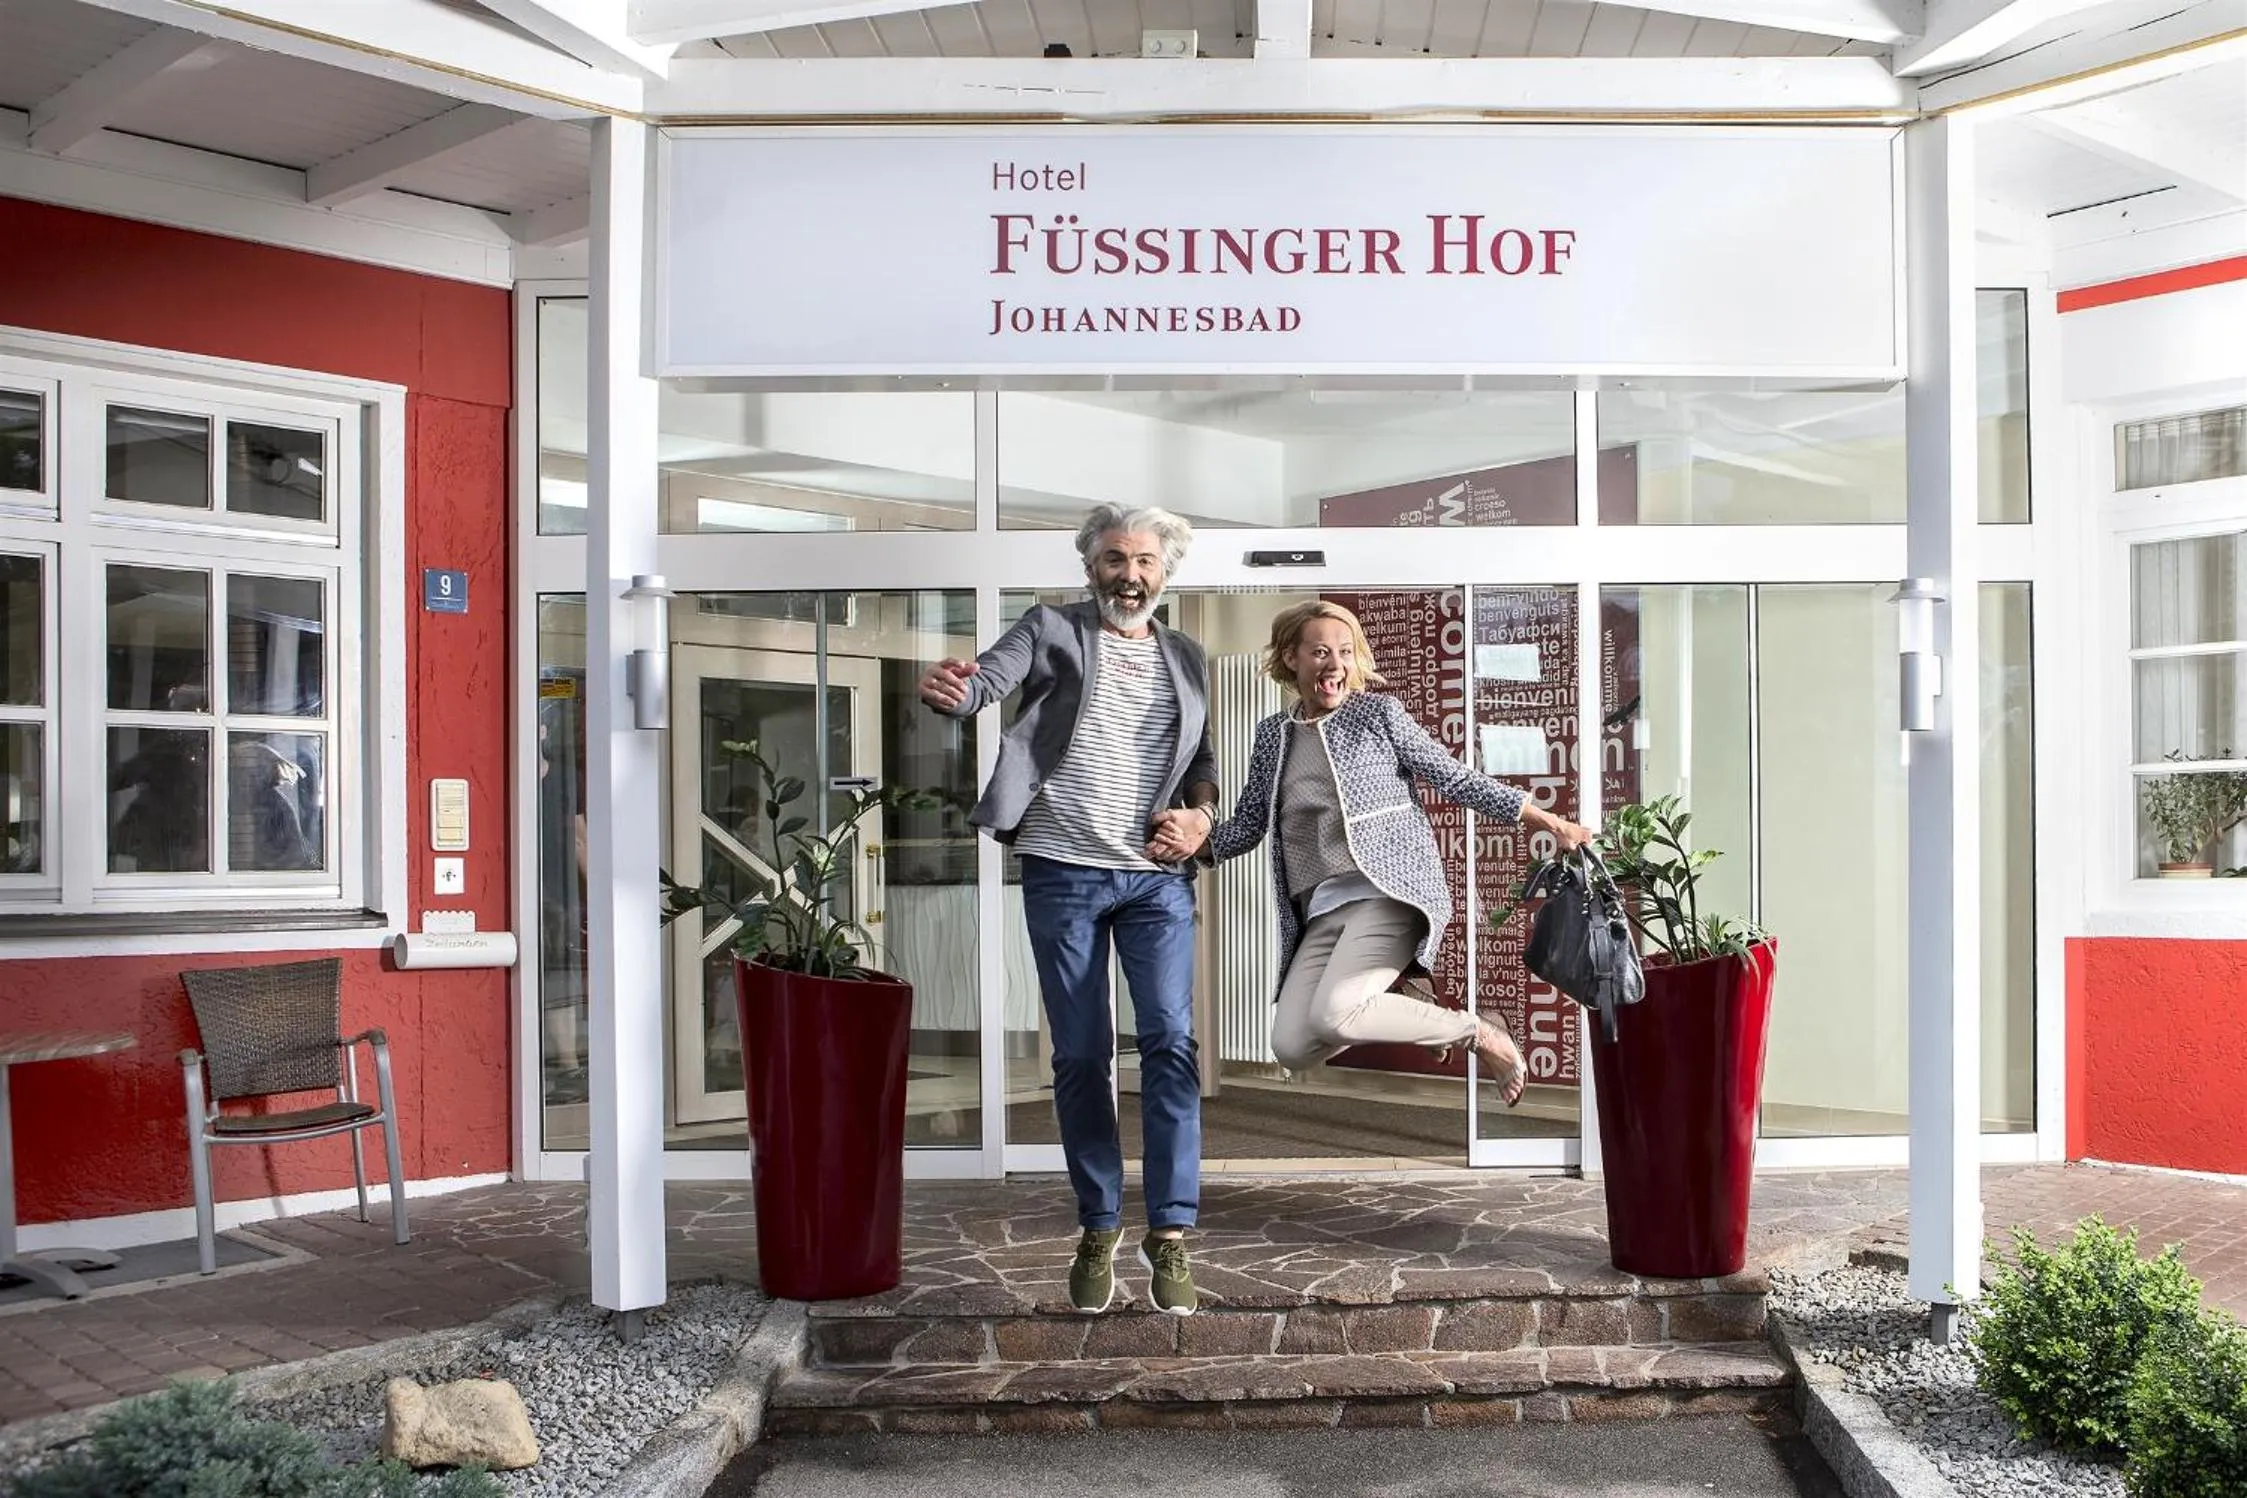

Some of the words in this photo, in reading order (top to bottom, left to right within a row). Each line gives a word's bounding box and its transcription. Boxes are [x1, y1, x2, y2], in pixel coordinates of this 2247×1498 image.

[992, 161, 1087, 192] Hotel
[989, 299, 1302, 336] JOHANNESBAD
[439, 574, 452, 596] 9
[1603, 629, 1615, 713] willkomme
